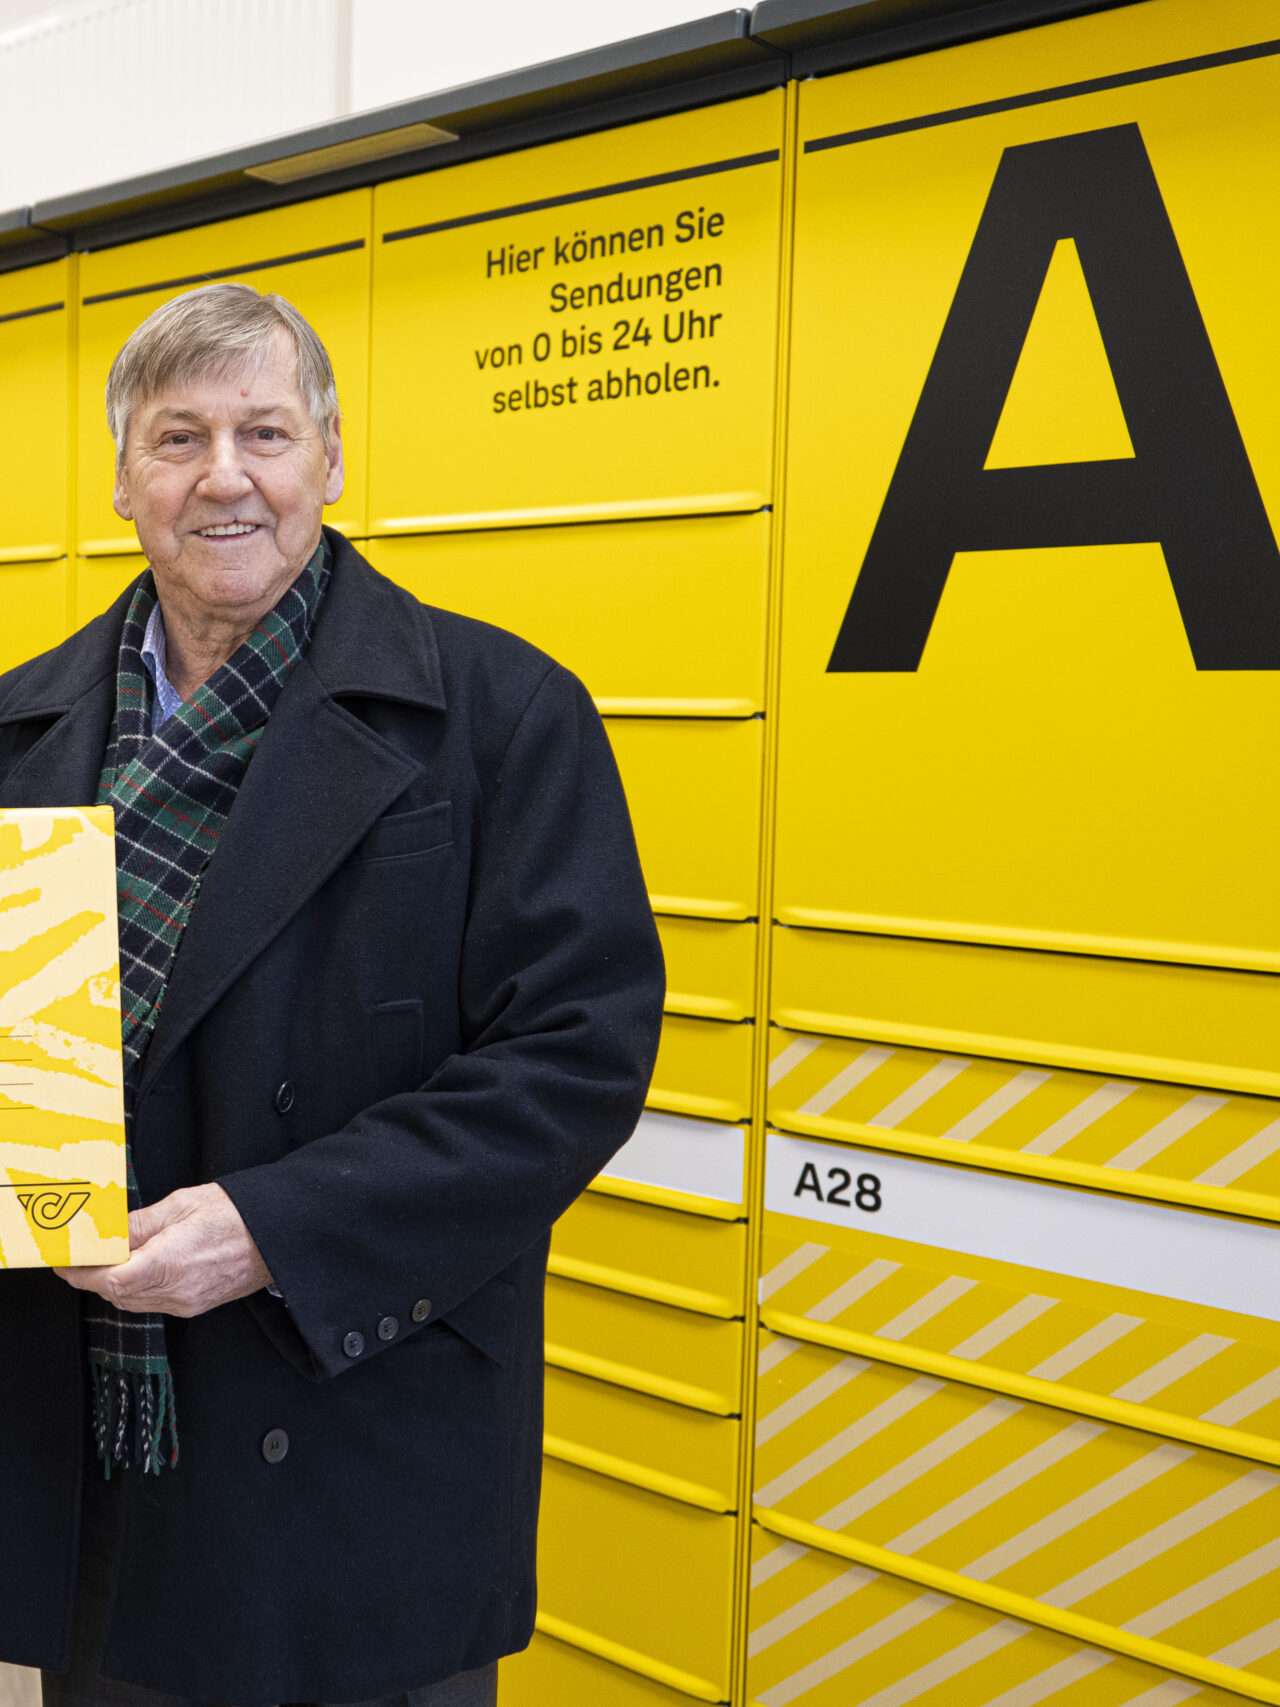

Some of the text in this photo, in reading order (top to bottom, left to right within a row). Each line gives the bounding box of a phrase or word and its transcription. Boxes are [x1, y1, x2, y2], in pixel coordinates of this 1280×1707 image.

[486, 206, 725, 279] Hier können Sie
[549, 261, 722, 313] Sendungen
[474, 309, 723, 370] von 0 bis 24 Uhr
[492, 361, 720, 414] selbst abholen.
[825, 122, 1280, 673] A
[793, 1161, 883, 1213] A28
